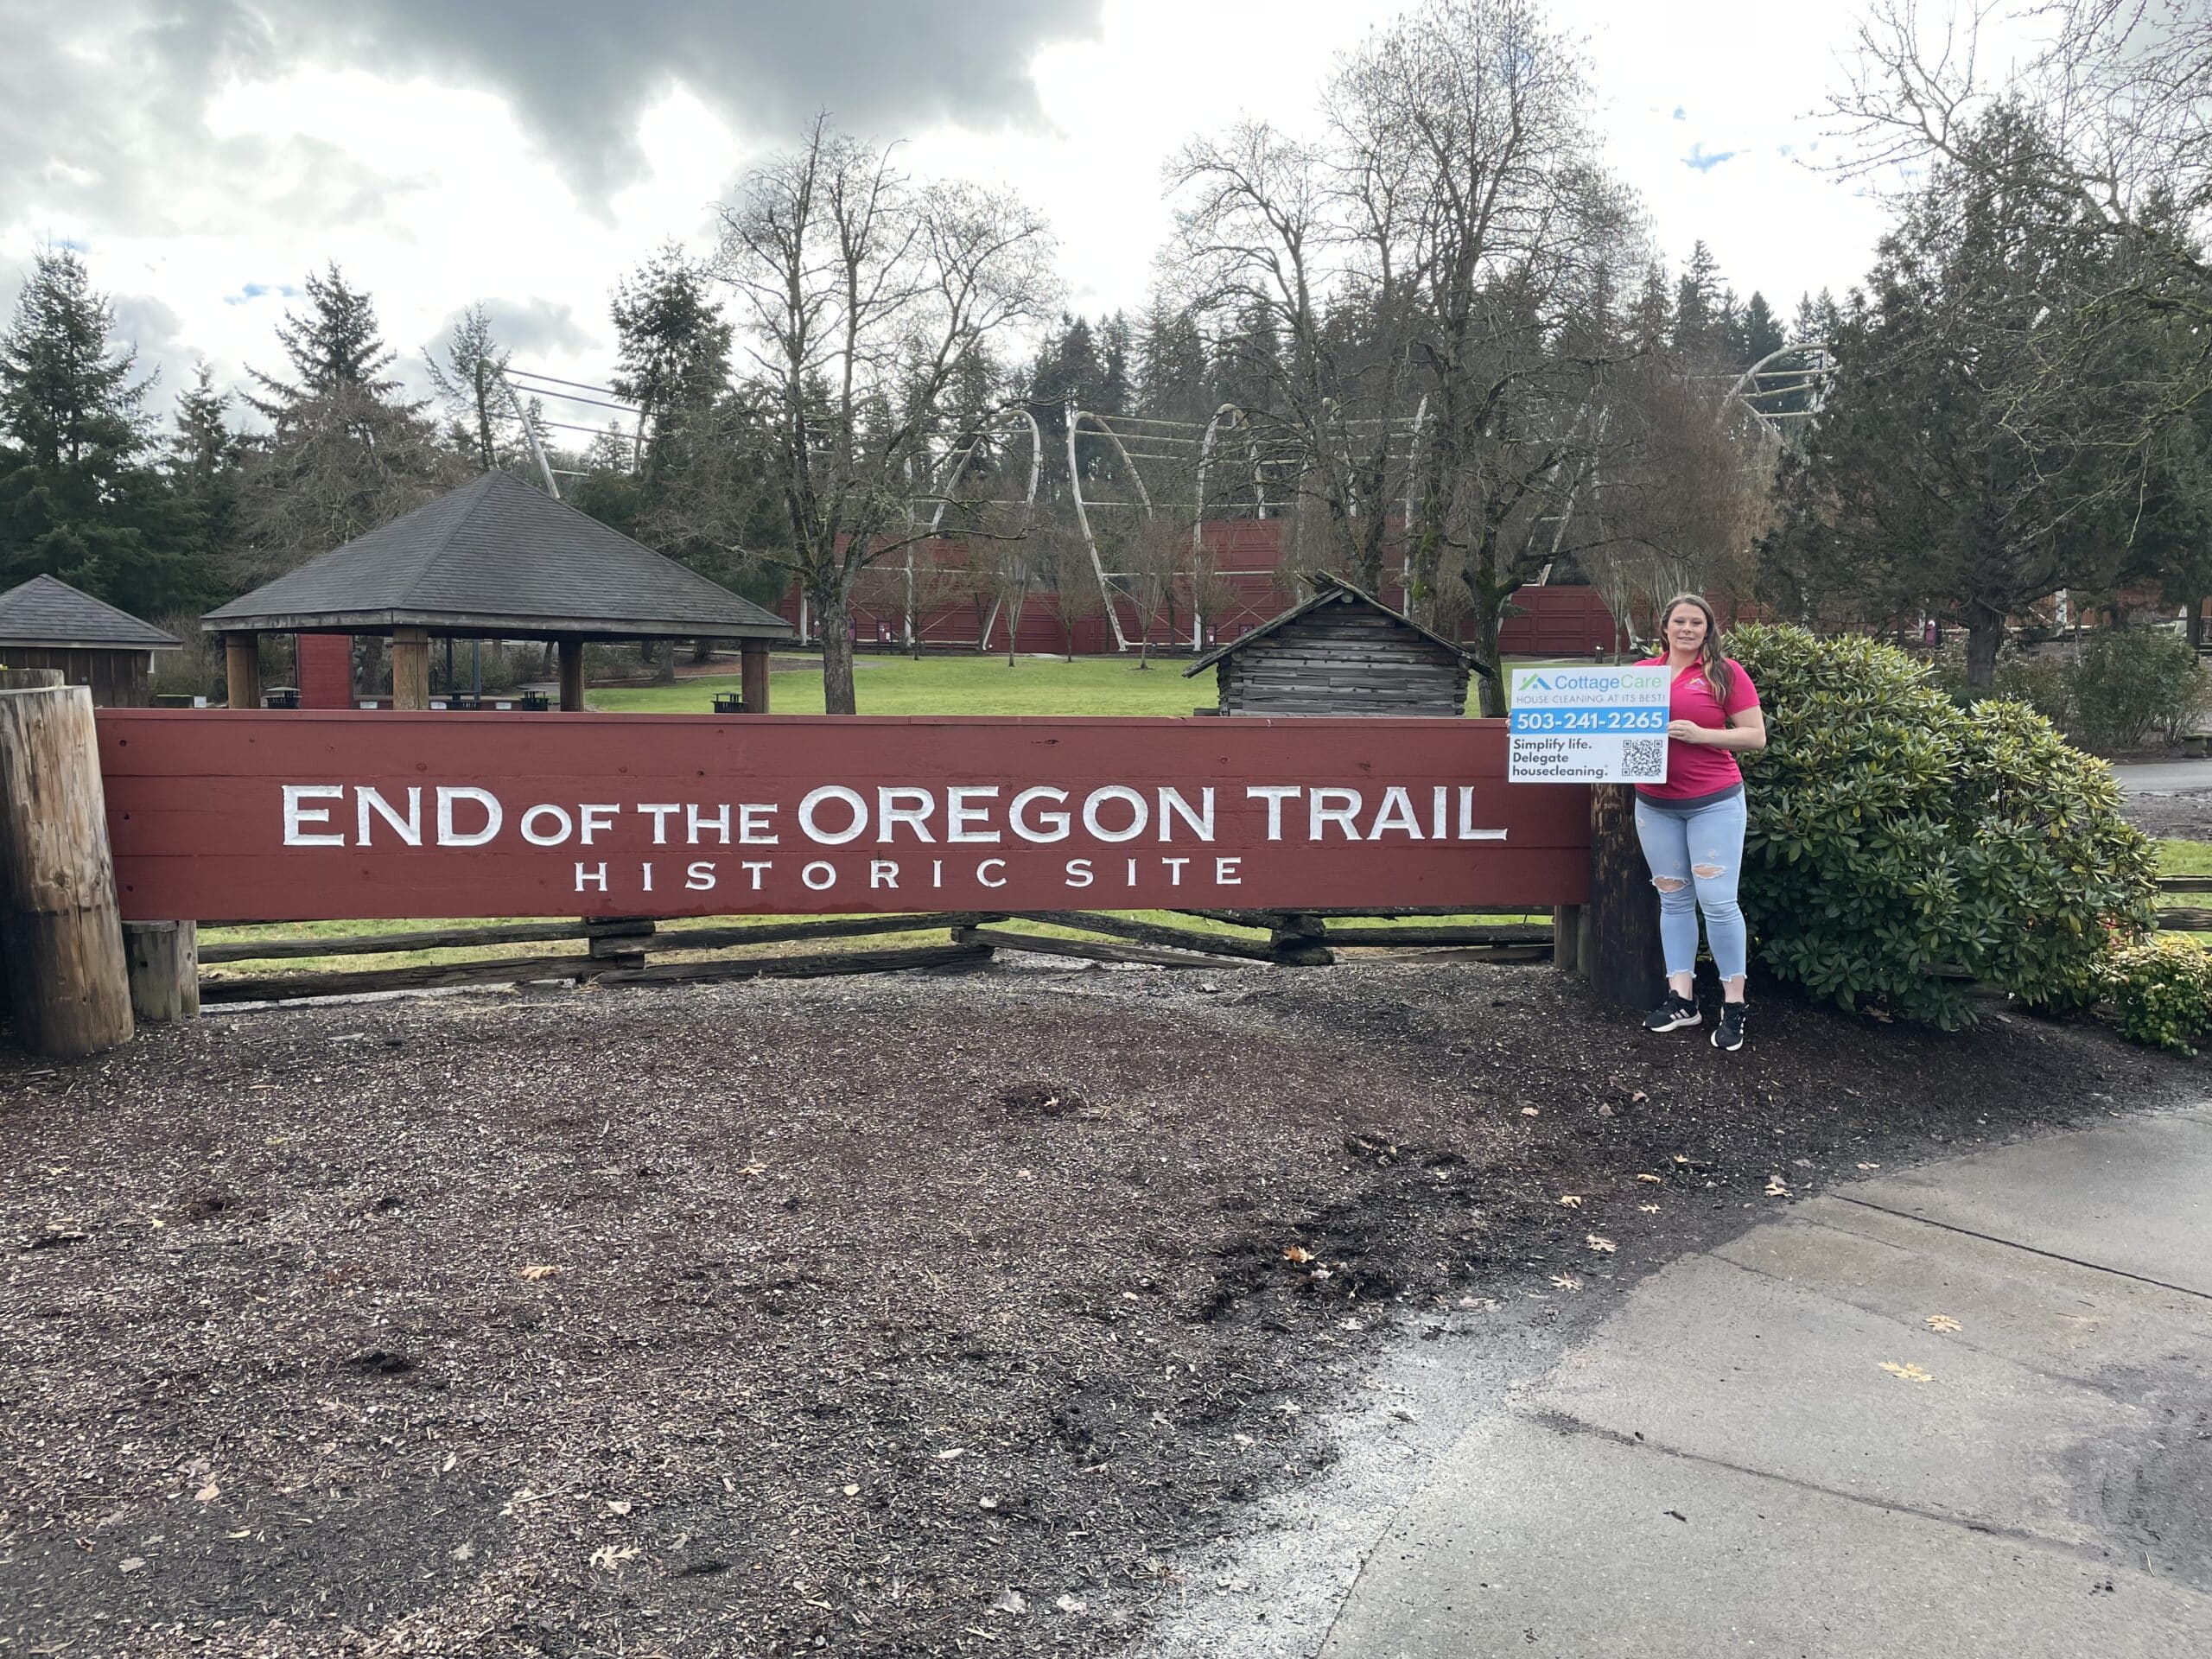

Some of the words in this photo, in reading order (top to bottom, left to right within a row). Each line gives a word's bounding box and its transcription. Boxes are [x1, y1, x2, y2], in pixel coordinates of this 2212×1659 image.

[1555, 674, 1662, 692] CottageCare
[1516, 696, 1549, 704] HOUSE
[1553, 694, 1604, 703] CLEANING
[1607, 694, 1620, 702] AT
[1623, 694, 1636, 702] ITS
[1639, 694, 1665, 702] BEST!
[1517, 712, 1663, 730] 503-241-2265
[1514, 738, 1565, 751] Simplify
[1568, 738, 1592, 749] life.
[1513, 752, 1569, 766] Delegate
[1512, 766, 1608, 779] housecleaning.
[281, 785, 503, 847] END
[520, 804, 620, 846] OF
[637, 804, 779, 844] THE
[798, 785, 1216, 845] OREGON
[1246, 785, 1509, 841] TRAIL
[574, 858, 1007, 892] HISTORIC
[1065, 856, 1242, 887] SITE
